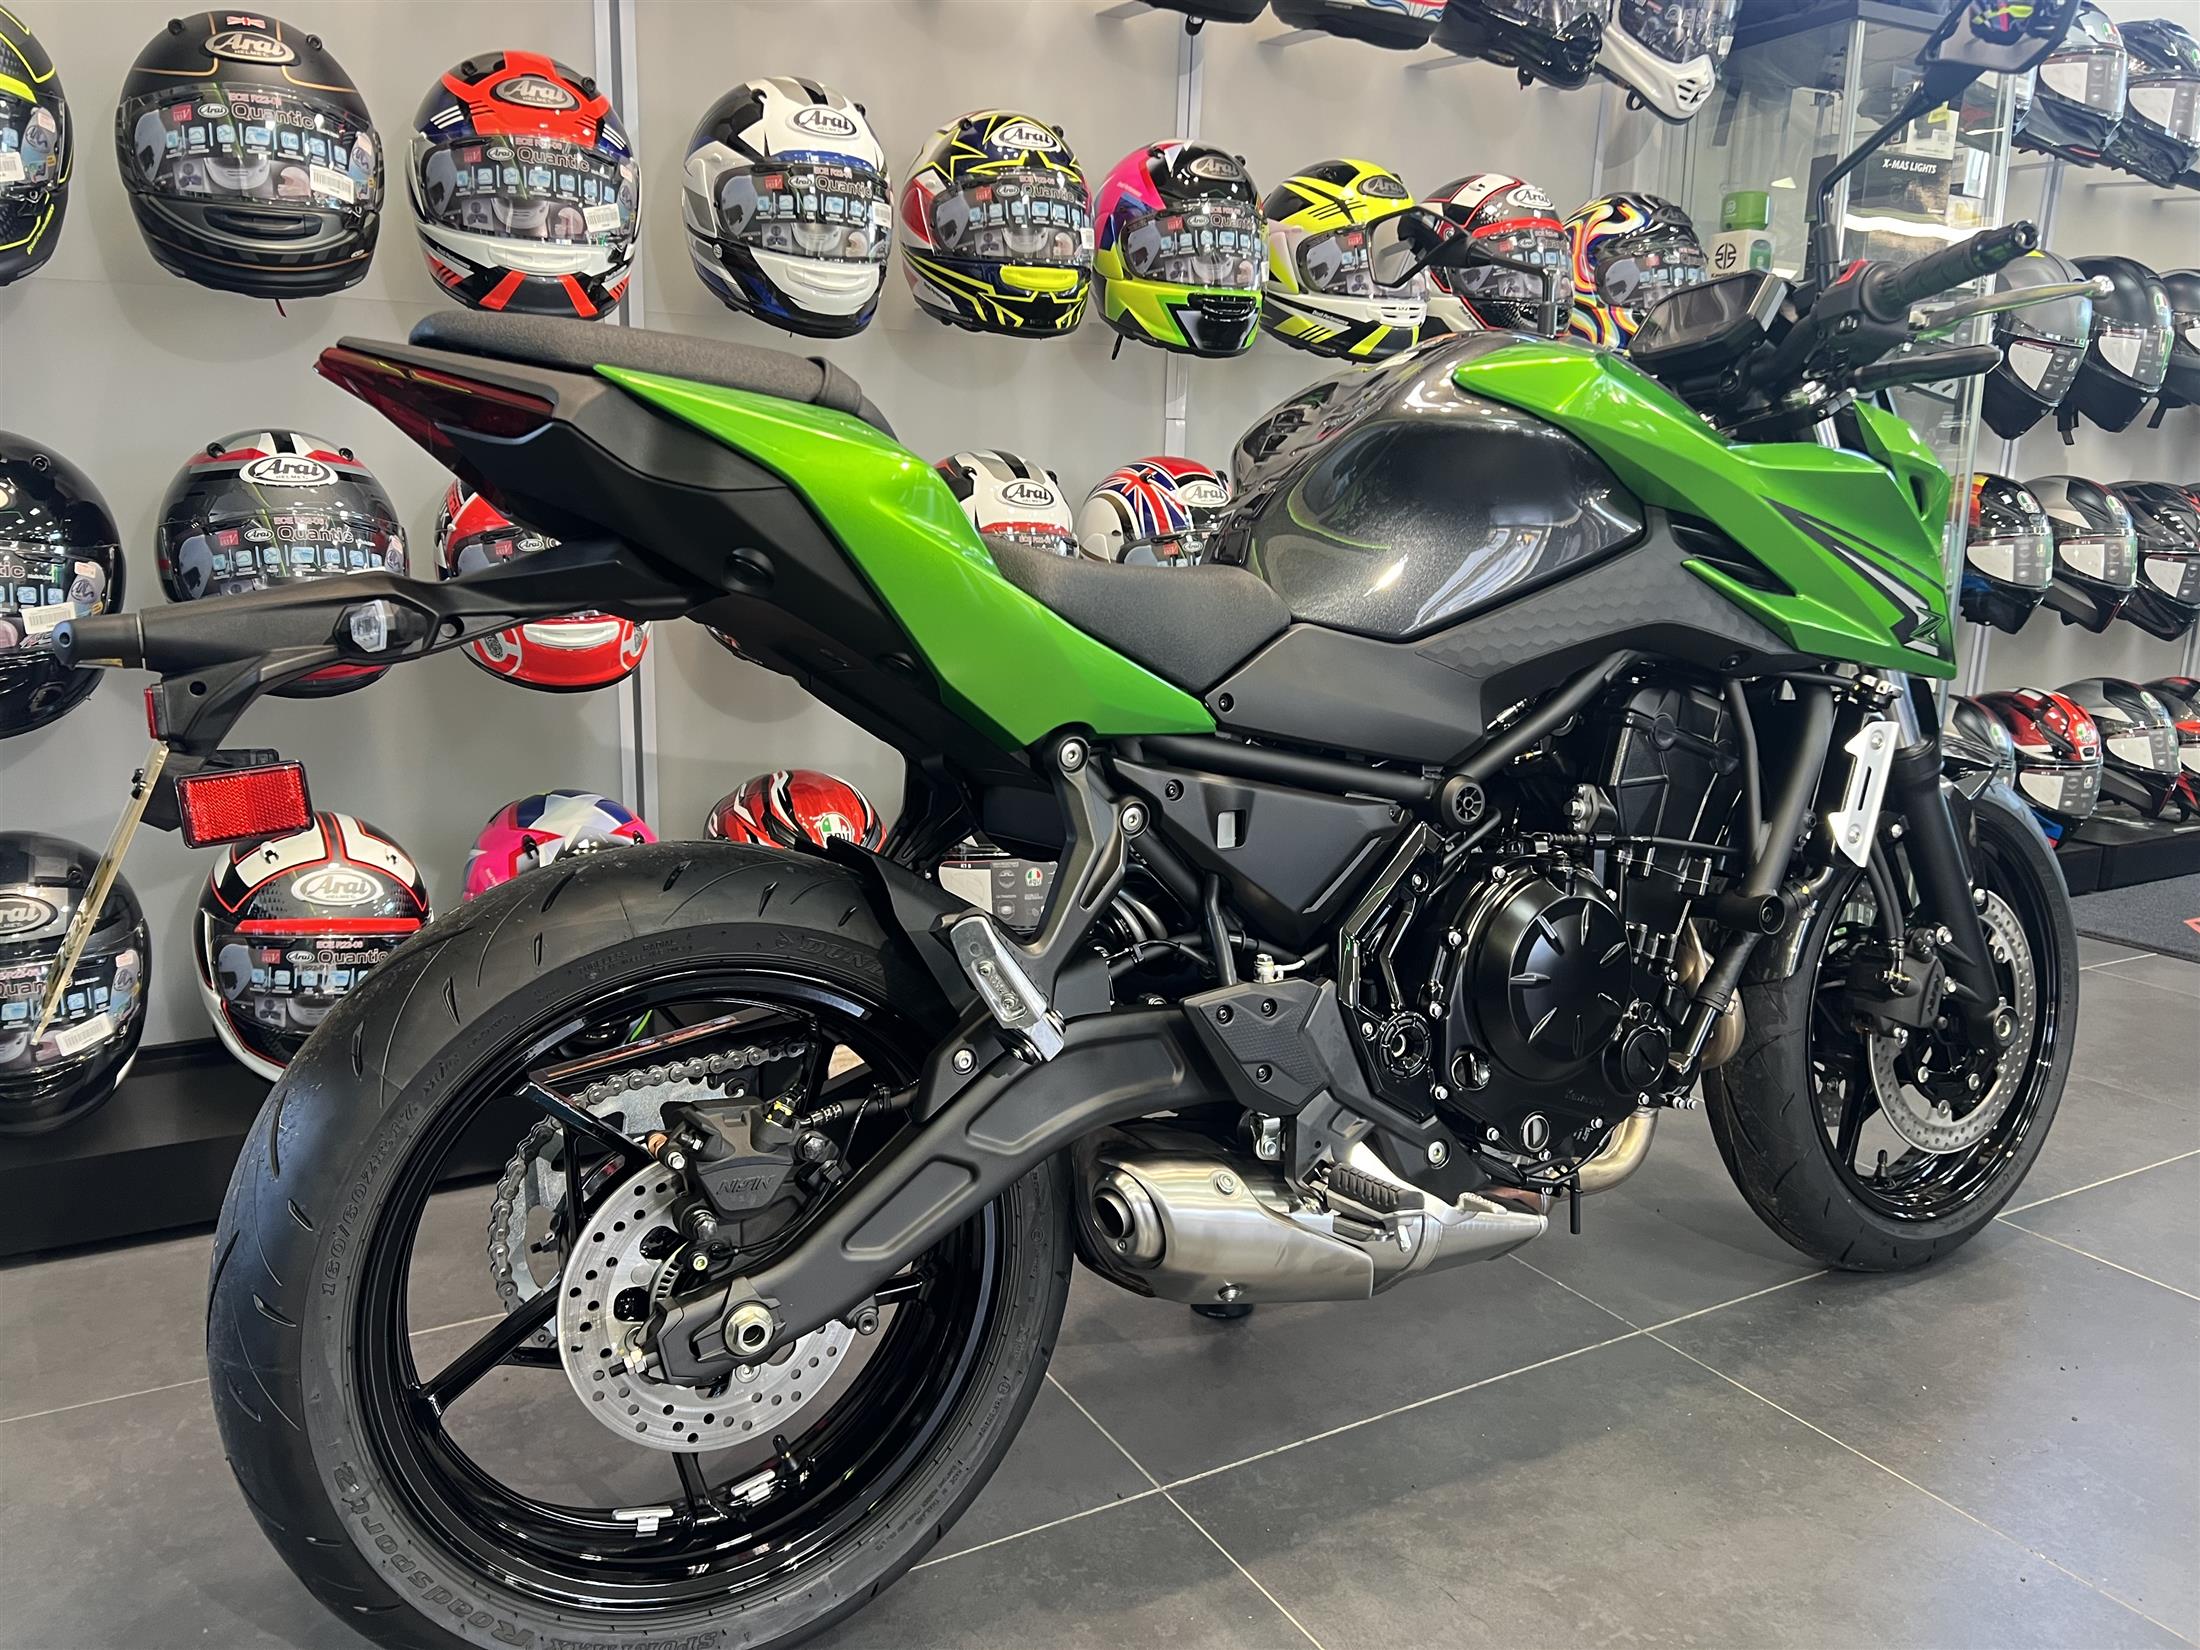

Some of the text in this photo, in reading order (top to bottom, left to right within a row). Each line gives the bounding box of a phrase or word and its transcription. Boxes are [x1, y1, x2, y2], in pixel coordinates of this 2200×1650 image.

[212, 33, 284, 56] Arai
[505, 80, 566, 101] Arai
[203, 104, 224, 115] Arai
[231, 102, 315, 130] Quantic
[801, 110, 850, 131] Arai
[1004, 128, 1050, 143] Arai
[491, 149, 511, 158] Arai
[517, 147, 590, 172] Quantic
[1201, 158, 1238, 176] Arai
[1882, 158, 1937, 175] X-MAS LIGHTS
[792, 177, 811, 187] Arai
[816, 175, 872, 198] Quantic
[1001, 186, 1017, 195] Arai
[254, 458, 320, 478] Arai
[1003, 484, 1048, 501] Arai
[1190, 484, 1224, 500] Arai
[248, 528, 270, 539] Arai
[277, 525, 354, 544] Quantic
[523, 540, 541, 548] Arai
[308, 875, 370, 896] Arai
[0, 906, 38, 923] rai
[316, 940, 334, 949] ECE
[290, 952, 312, 963] Arai
[340, 1496, 536, 1649] Roadsport
